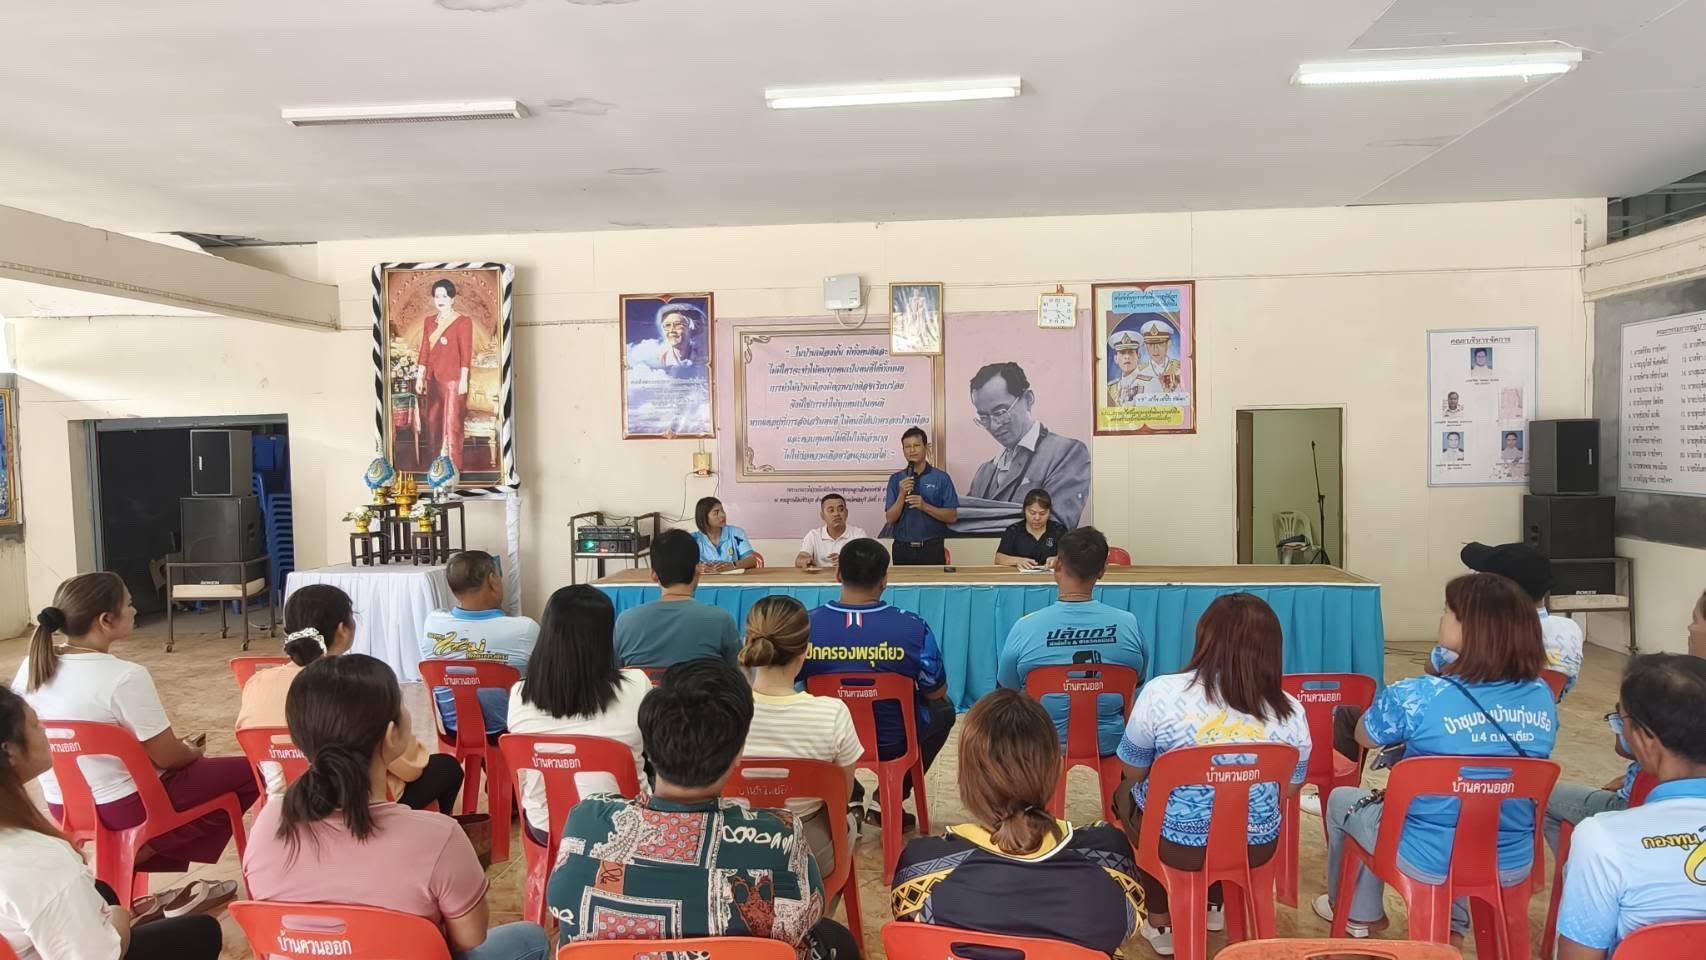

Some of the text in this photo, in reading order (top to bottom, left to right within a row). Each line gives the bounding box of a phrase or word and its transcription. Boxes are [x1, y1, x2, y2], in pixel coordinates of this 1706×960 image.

[1297, 690, 1342, 703] บ้านควนออก
[1490, 730, 1535, 743] ต.พเดียว
[48, 741, 82, 753] ควนออก
[268, 744, 306, 760] บ้านควน
[531, 753, 582, 769] บ้านควนออก
[1206, 767, 1261, 783] บ้านควนออก
[1452, 776, 1515, 794] บ้านควนออก
[277, 929, 353, 956] บ้านควนออก
